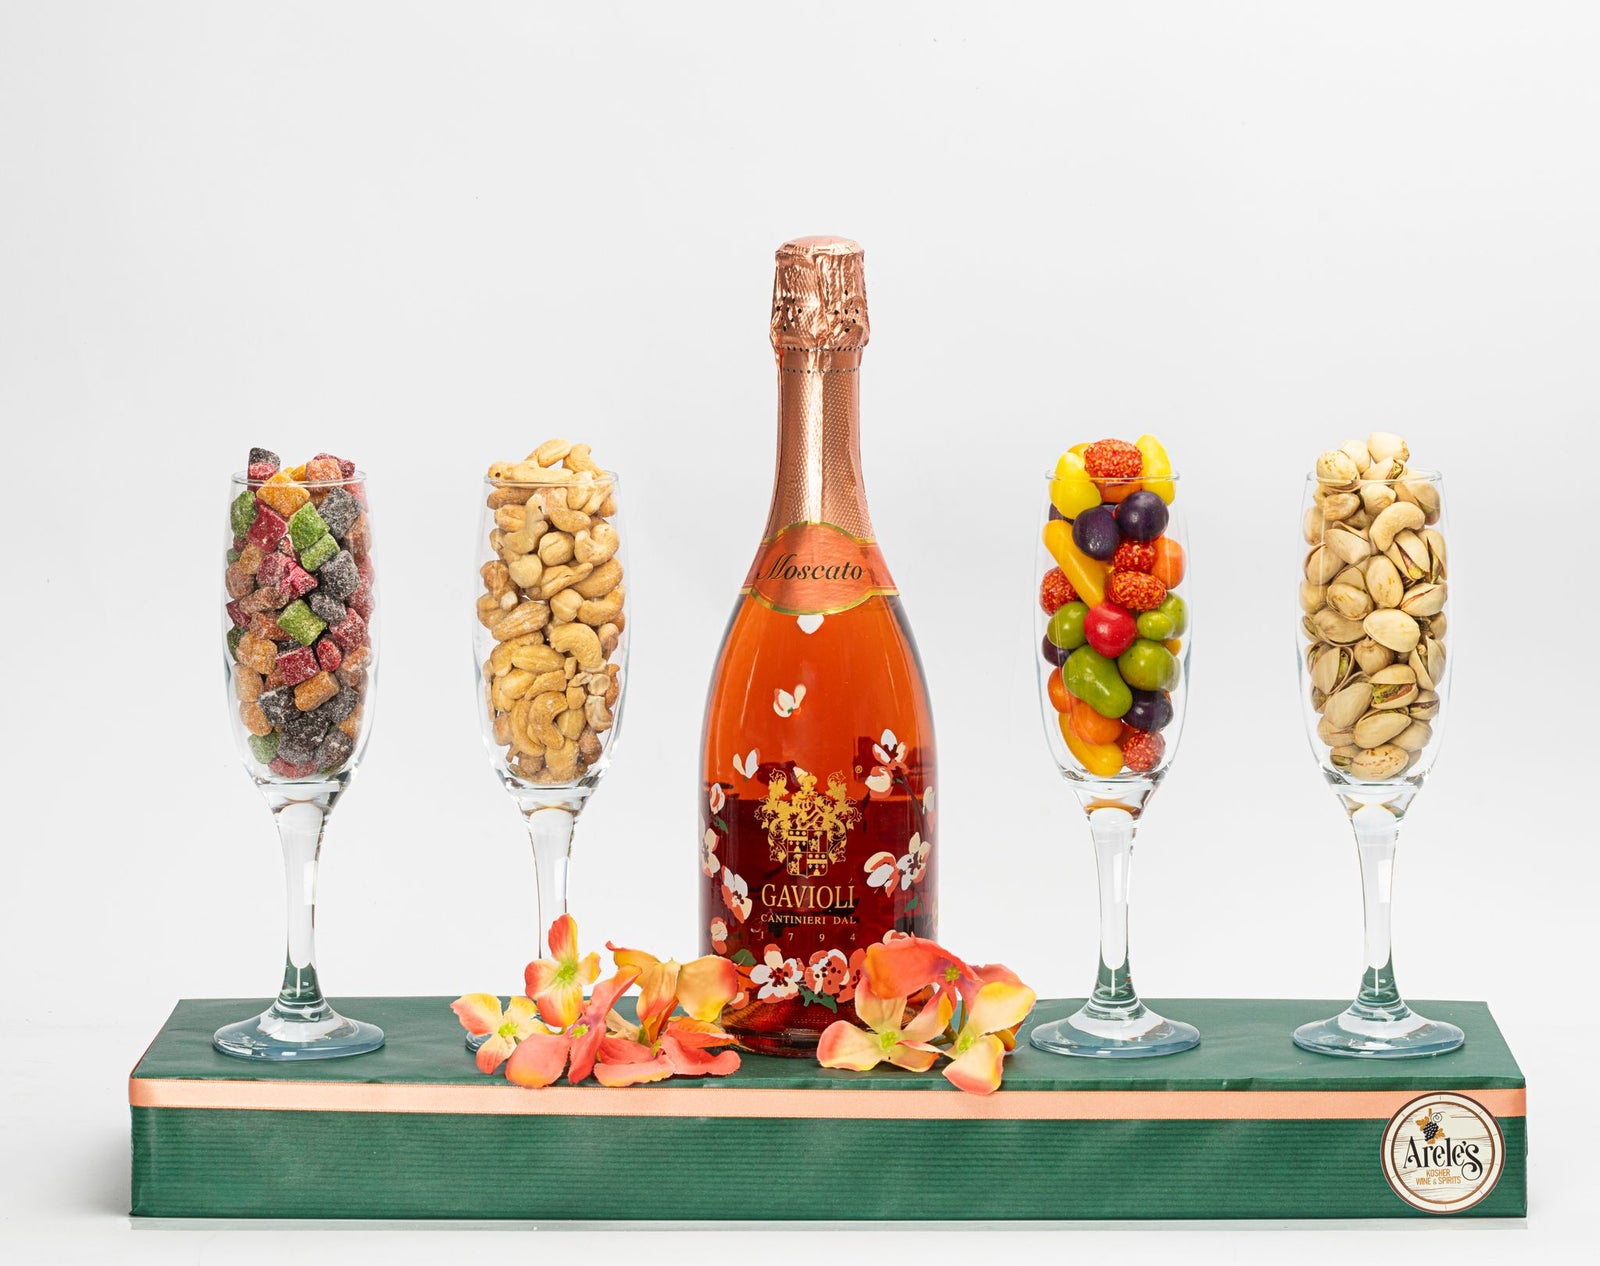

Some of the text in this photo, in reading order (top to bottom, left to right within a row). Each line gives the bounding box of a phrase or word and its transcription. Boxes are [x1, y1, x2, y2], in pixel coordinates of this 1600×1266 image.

[756, 553, 863, 580] Moscato
[760, 914, 857, 925] CANTINIERI DAL
[1403, 1136, 1483, 1181] Arele's
[1426, 1169, 1451, 1177] KOSHER
[1416, 1177, 1431, 1185] WINE
[1438, 1176, 1462, 1185] SPIRITS
